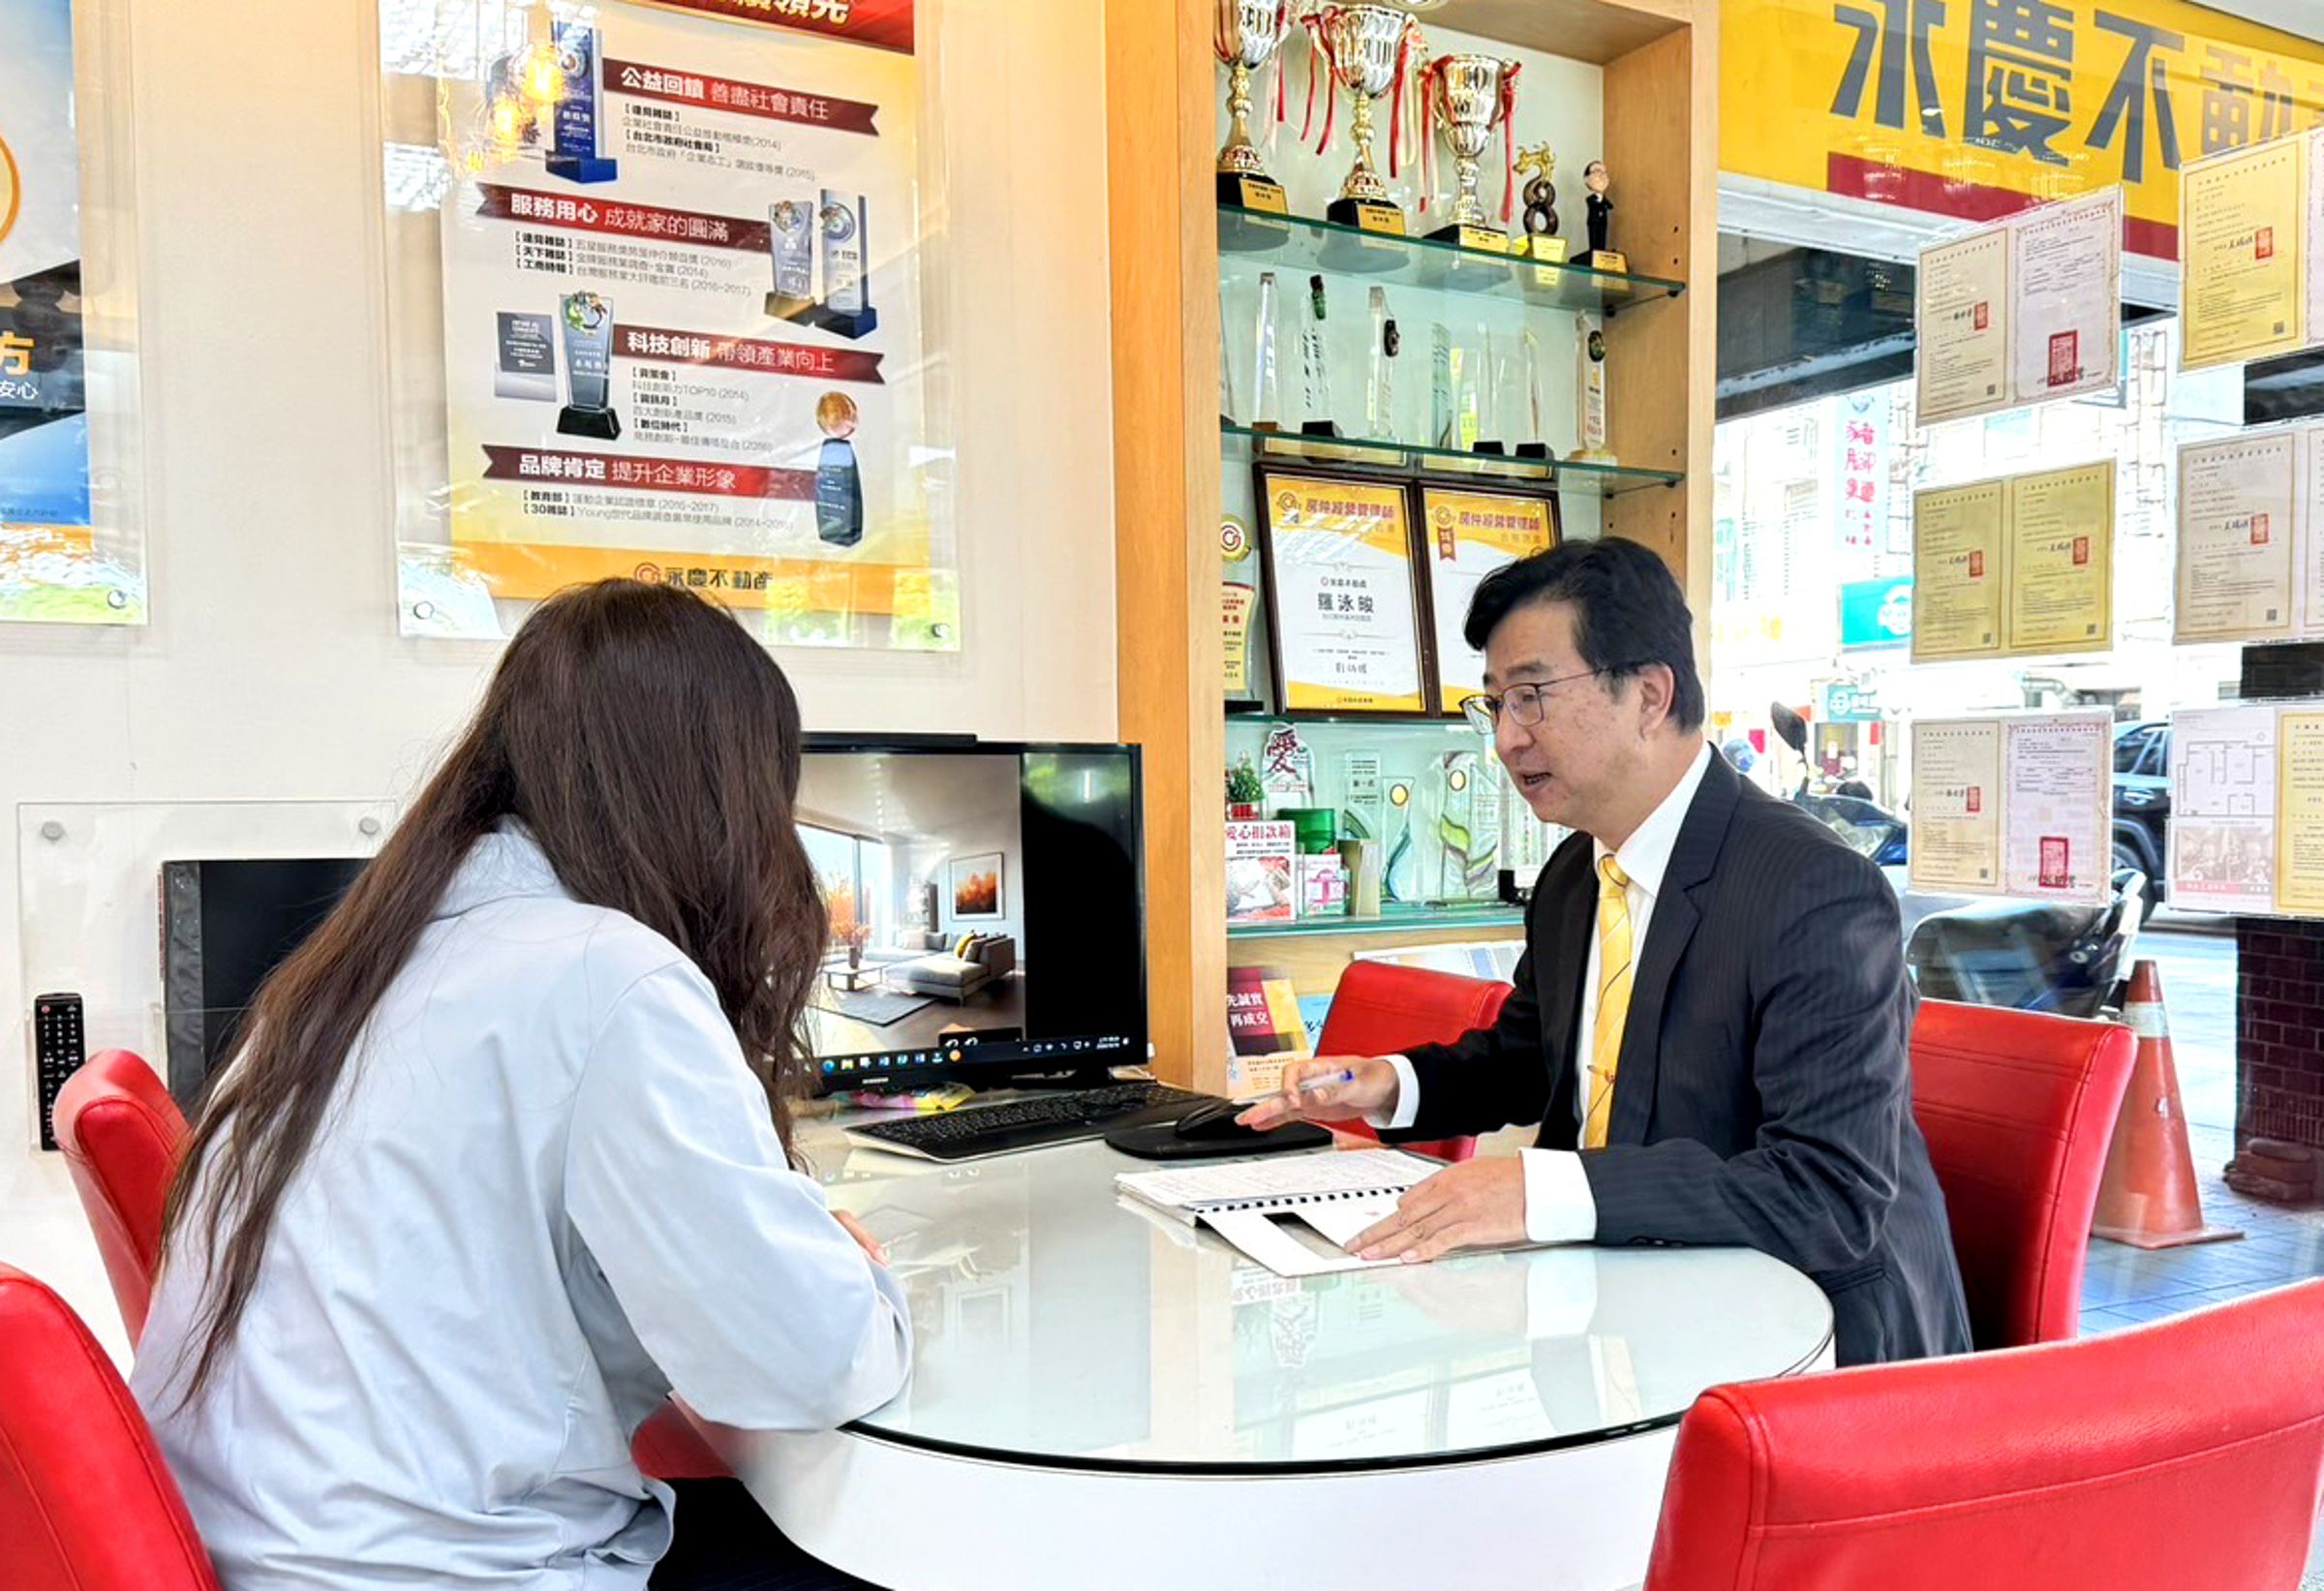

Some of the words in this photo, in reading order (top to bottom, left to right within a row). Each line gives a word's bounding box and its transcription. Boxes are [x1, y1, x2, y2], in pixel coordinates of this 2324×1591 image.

[621, 67, 705, 100] 公益回饋
[711, 82, 829, 120] 善盡社會責任
[1829, 0, 2324, 184] 永慶不動
[510, 193, 598, 225] 服務用心
[604, 207, 728, 242] 成就家的圓滿
[0, 331, 35, 376] 方
[627, 331, 711, 359] 科技創新
[717, 342, 836, 372] 帶領產業向上
[519, 453, 606, 480] 品牌肯定
[611, 462, 736, 490] 提升企業形象
[665, 567, 773, 590] 永慶不動產
[1267, 728, 1298, 774] 愛
[1226, 824, 1291, 841] 愛心捐款箱
[1231, 1012, 1269, 1026] 再成交
